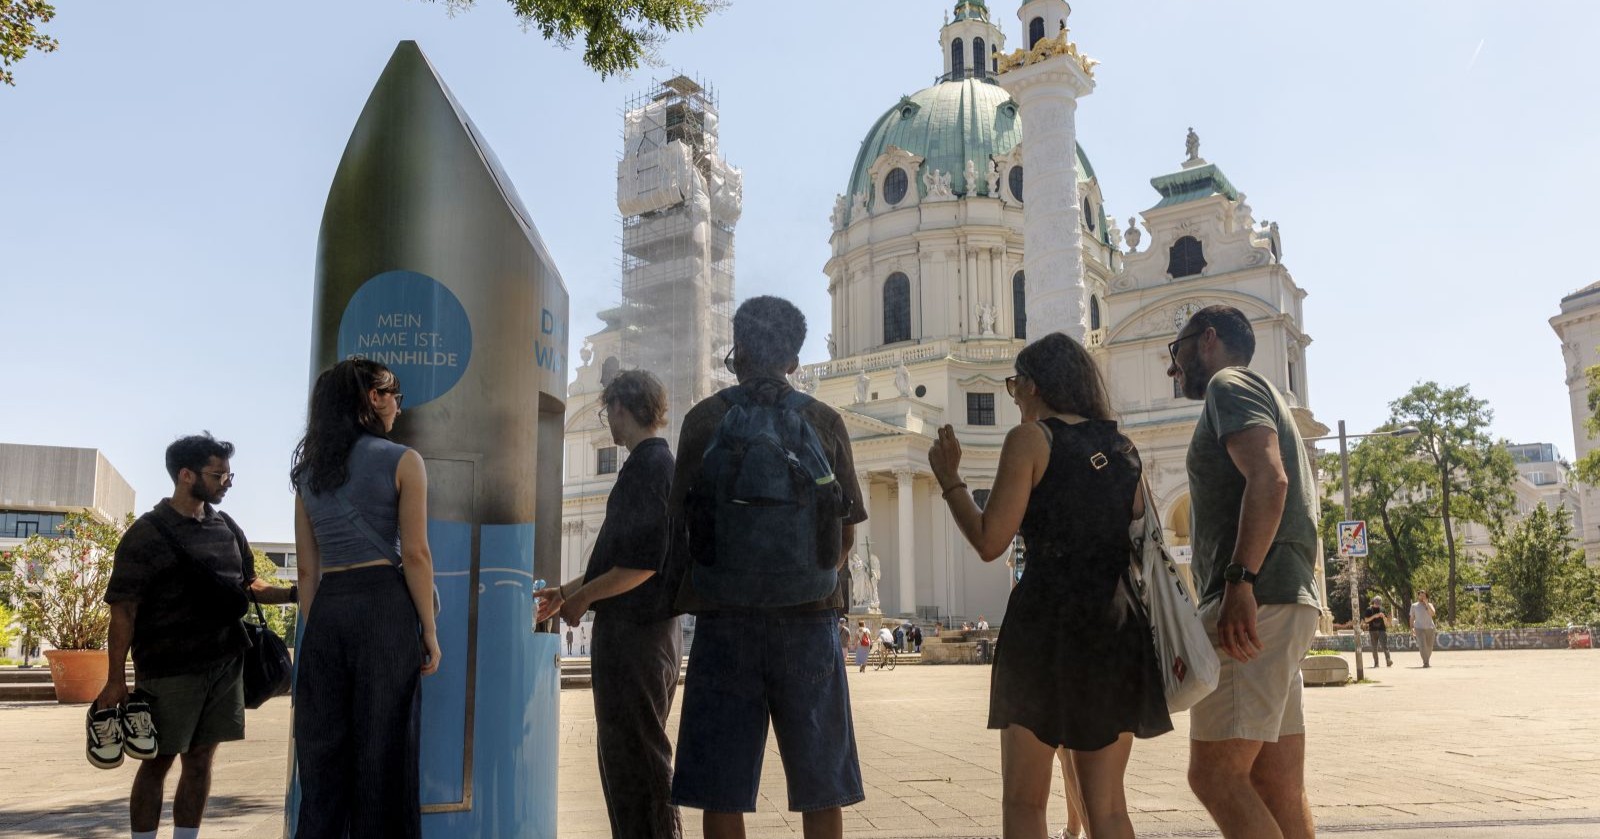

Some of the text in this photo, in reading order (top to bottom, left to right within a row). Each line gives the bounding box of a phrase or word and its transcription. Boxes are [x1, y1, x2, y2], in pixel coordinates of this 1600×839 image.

[377, 313, 422, 328] MEIN
[358, 332, 443, 348] NAME IST:
